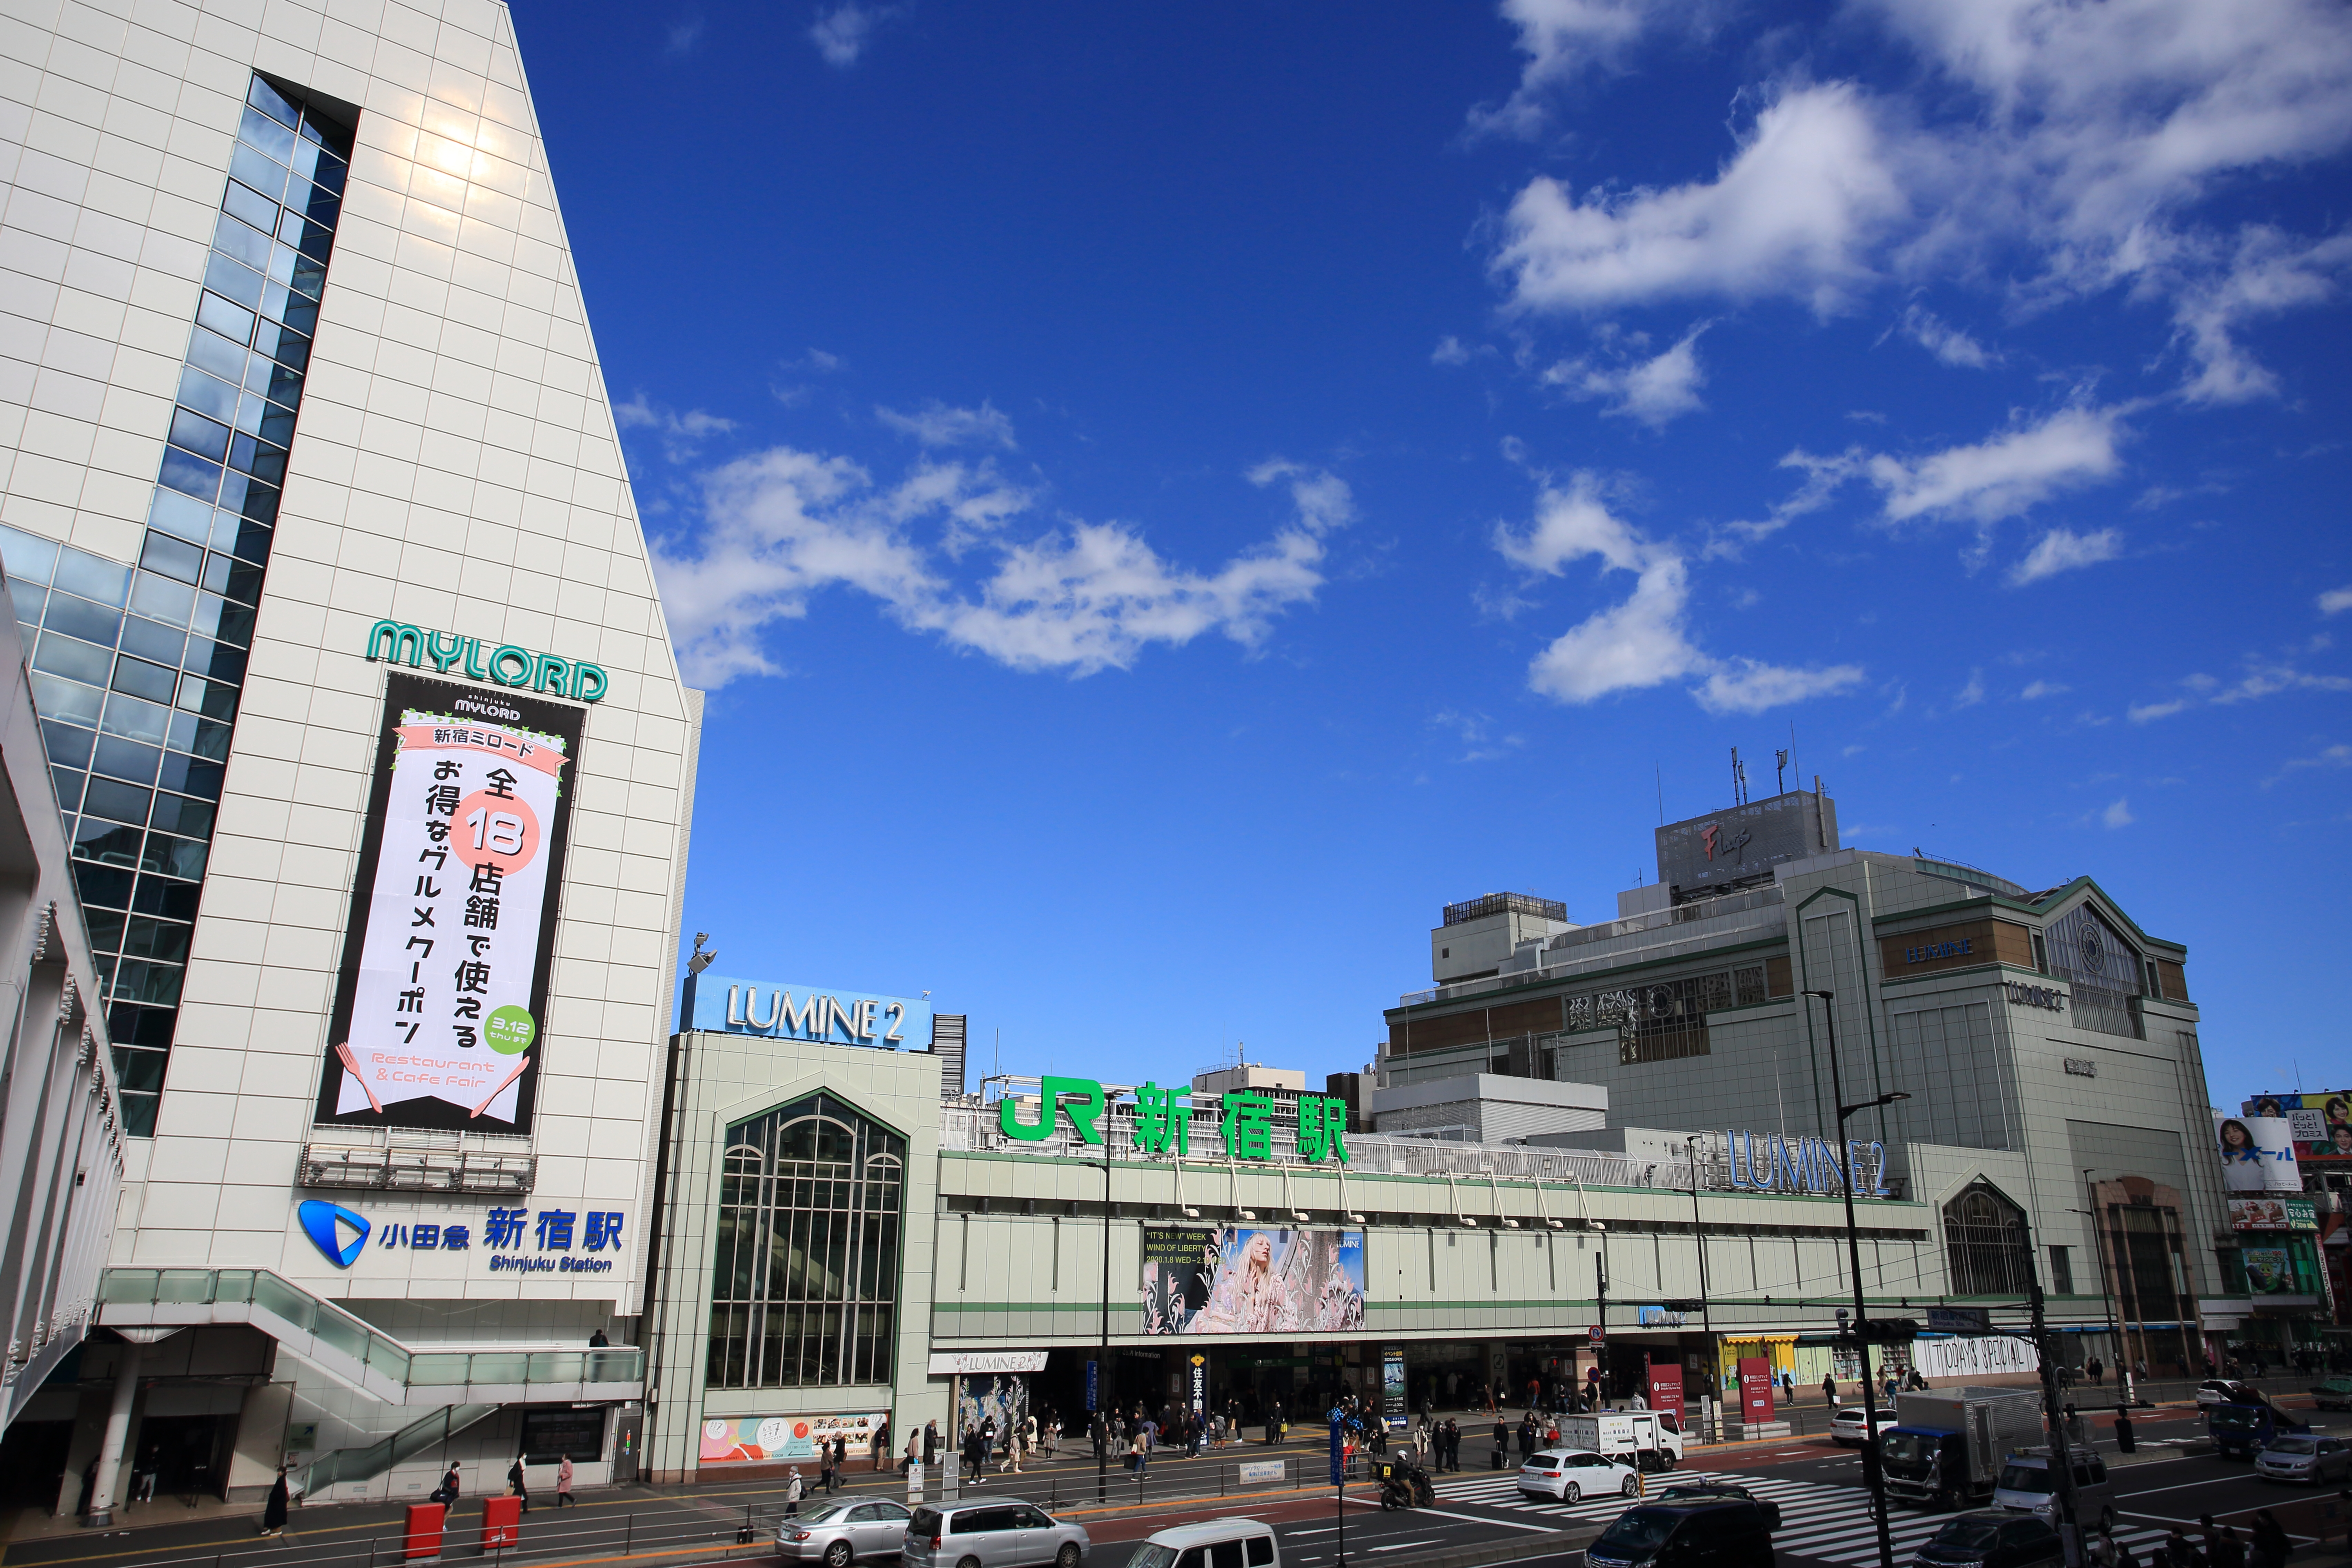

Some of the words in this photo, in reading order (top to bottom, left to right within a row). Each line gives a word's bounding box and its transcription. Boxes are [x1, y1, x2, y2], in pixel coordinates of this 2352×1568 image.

[367, 620, 608, 701] MYLORD
[455, 699, 521, 721] MYLORD
[468, 694, 511, 707] shinjuku
[434, 727, 535, 758] 新宿ミロード
[396, 760, 462, 1044] お得なグルメクーポン
[1906, 938, 1973, 964] LUMINE
[727, 984, 879, 1038] LUMINE
[885, 1002, 905, 1041] 2
[490, 1031, 511, 1040] thu
[492, 1017, 530, 1035] 3.12
[371, 1052, 495, 1074] Restaurant
[376, 1067, 388, 1082] &
[391, 1070, 441, 1086] Cafe
[445, 1073, 486, 1089] Fair
[2295, 1129, 2323, 1138] プロミス
[1727, 1129, 1867, 1194] LUMINE
[1871, 1140, 1891, 1195] 2
[379, 1223, 470, 1250] 小田急
[484, 1206, 624, 1251] 新宿駅
[1336, 1240, 1359, 1248] LUMINE
[490, 1255, 555, 1274] Shinjuku
[559, 1256, 612, 1272] Station
[969, 1357, 1017, 1370] LUMINE
[1018, 1356, 1027, 1369] 2
[1134, 1350, 1160, 1359] Information
[1981, 1339, 2024, 1368] SPECIAL
[763, 1435, 782, 1444] KITCHEN
[772, 1422, 780, 1436] 7
